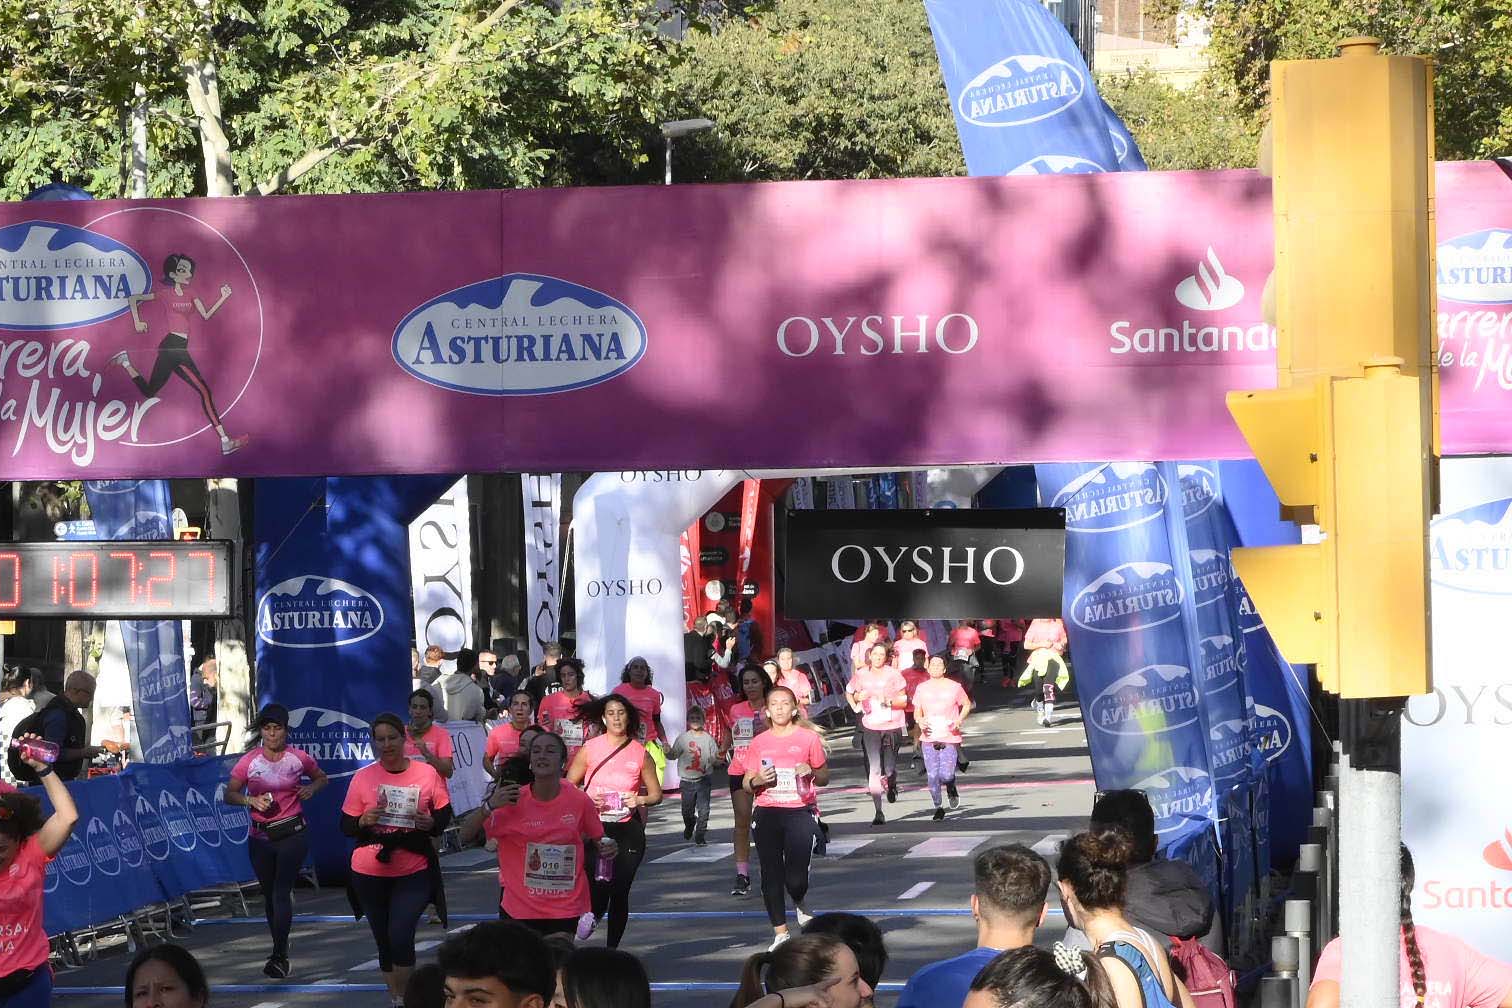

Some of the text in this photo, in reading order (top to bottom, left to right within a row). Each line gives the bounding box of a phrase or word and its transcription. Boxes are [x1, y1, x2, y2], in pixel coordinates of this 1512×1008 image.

[53, 256, 127, 270] LECHERA
[450, 314, 619, 330] CENTRAL LECHERA
[776, 313, 979, 358] OYSHO
[411, 320, 627, 366] ASTURIANA
[1110, 319, 1278, 354] Santand
[1459, 340, 1478, 368] la
[13, 370, 162, 468] Mujer
[620, 470, 702, 484] OYSHO
[831, 543, 1025, 586] OYSHO
[586, 577, 663, 599] OYSHO
[272, 598, 370, 609] CENTRAL LECHERA
[261, 607, 375, 633] ASTURIANA
[1404, 683, 1512, 727] OYS
[296, 741, 376, 761] URIANA
[1422, 880, 1512, 910] Santa
